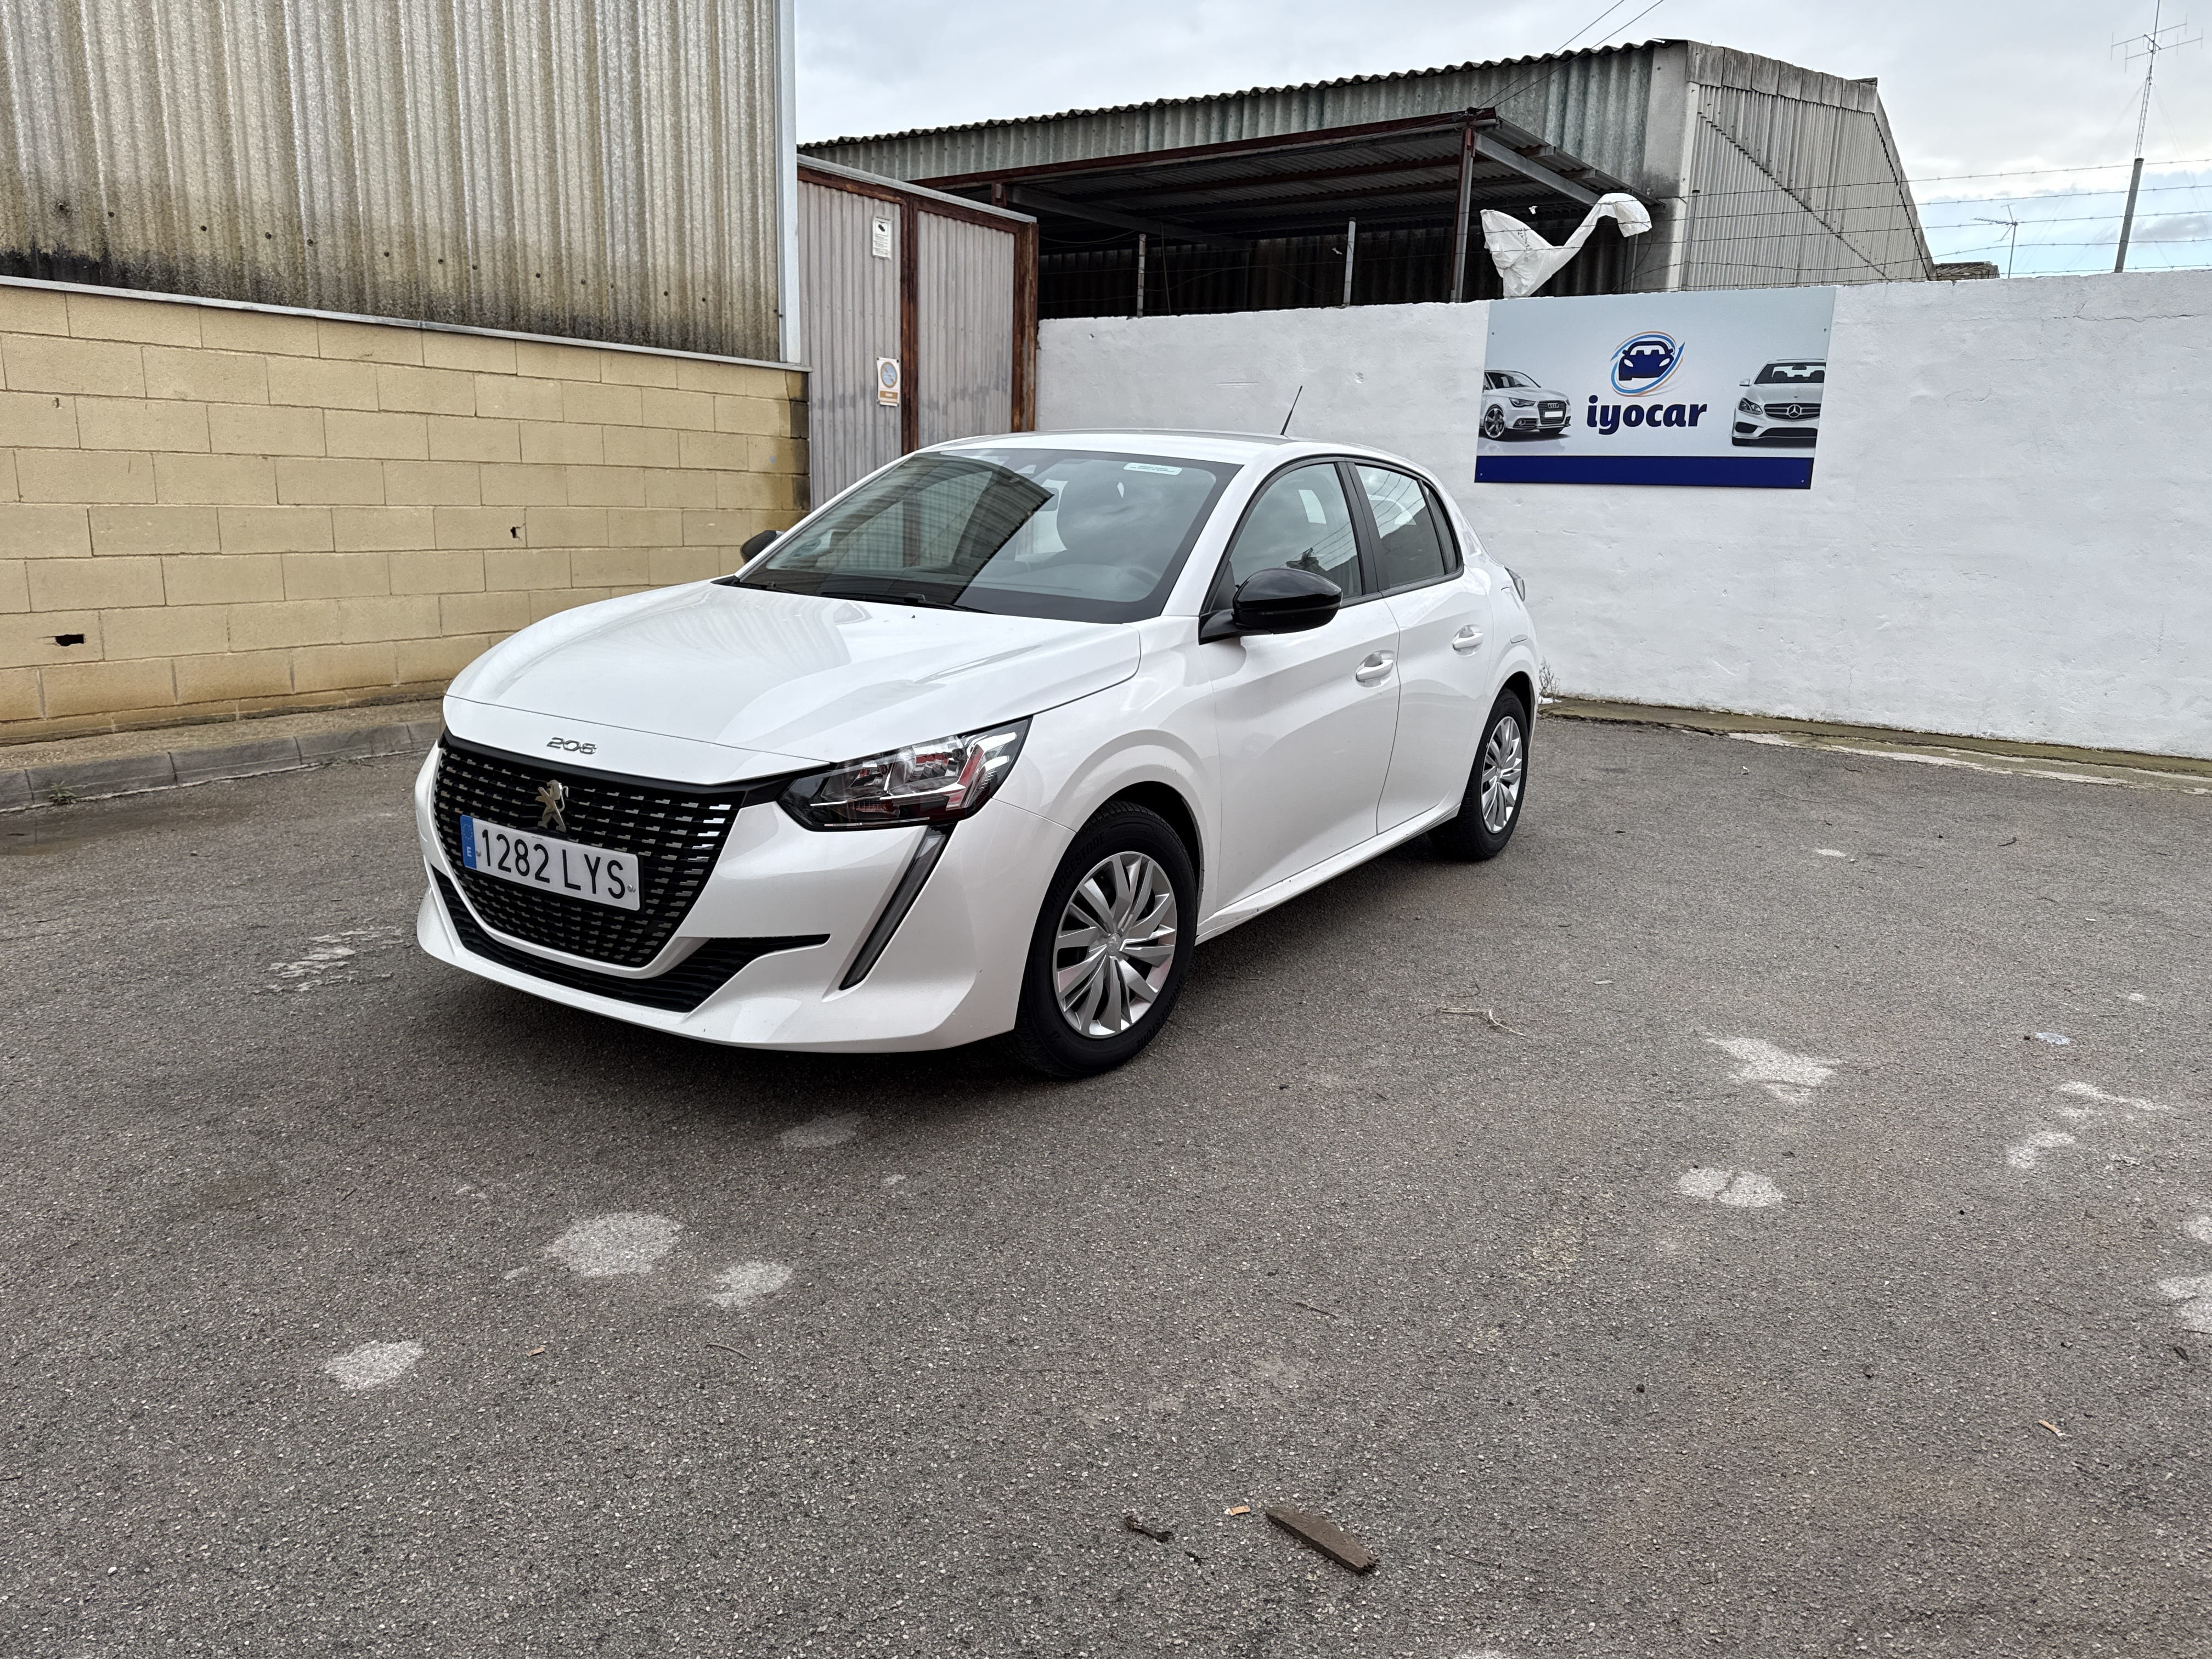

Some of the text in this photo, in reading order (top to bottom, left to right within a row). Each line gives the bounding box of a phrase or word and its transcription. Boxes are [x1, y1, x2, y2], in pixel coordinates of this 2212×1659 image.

[1587, 394, 1707, 435] iyocar
[546, 737, 597, 754] 208
[466, 829, 625, 899] E 1282 LYS
